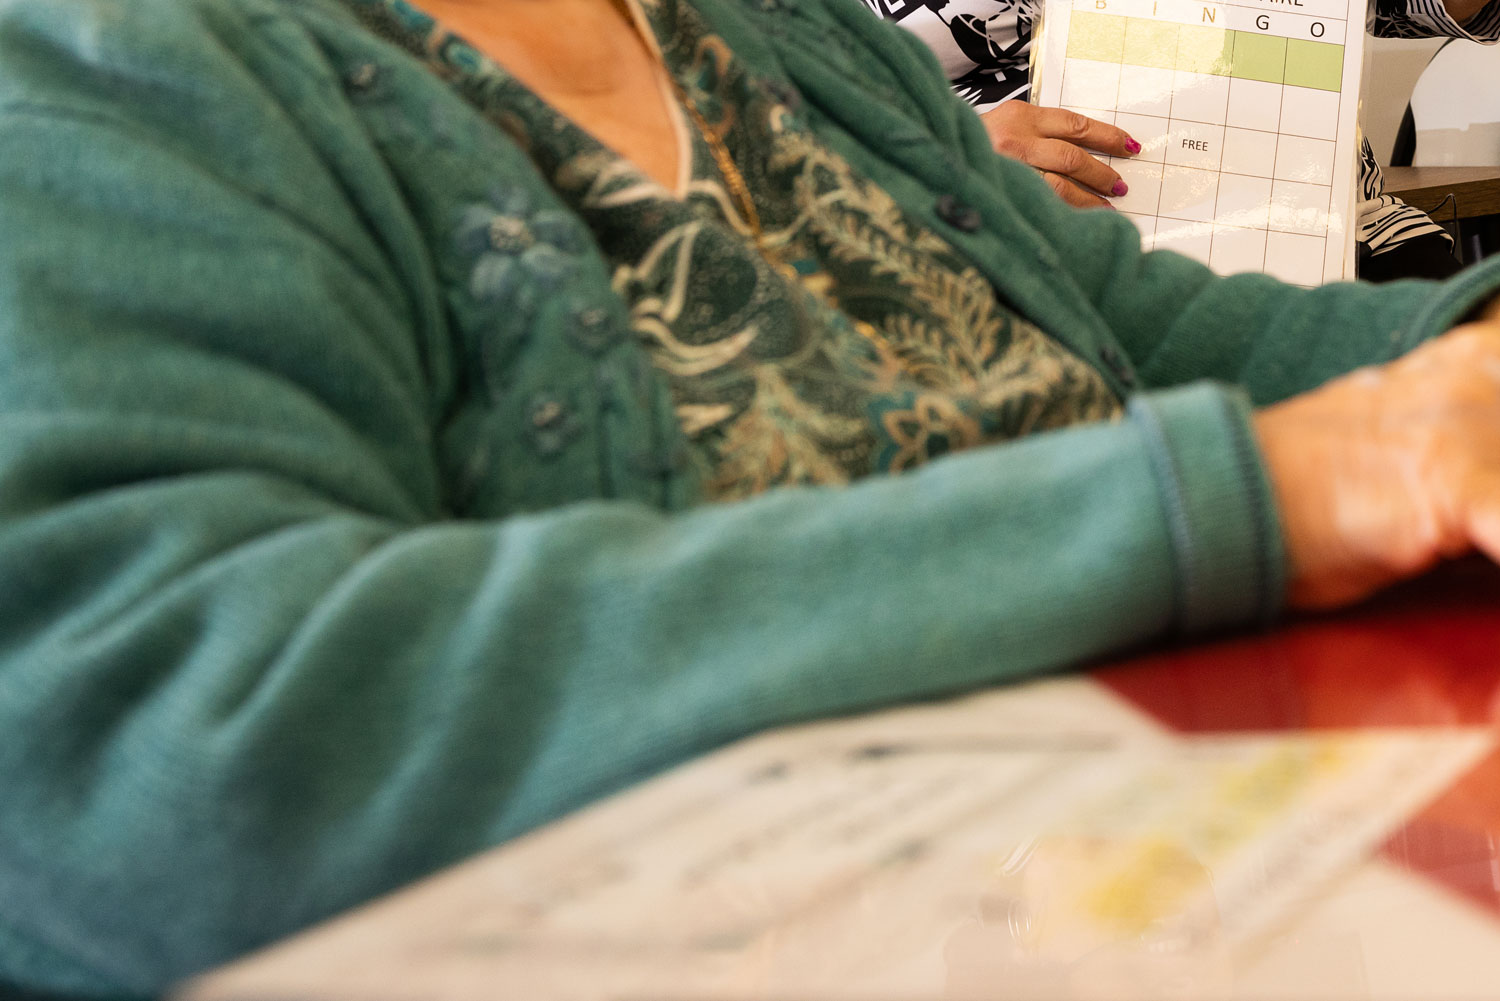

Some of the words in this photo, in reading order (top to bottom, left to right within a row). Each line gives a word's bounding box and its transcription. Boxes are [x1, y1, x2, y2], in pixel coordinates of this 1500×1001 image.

[1203, 8, 1217, 24] N
[1255, 14, 1271, 31] G
[1309, 21, 1326, 38] O
[1181, 138, 1209, 153] FREE
